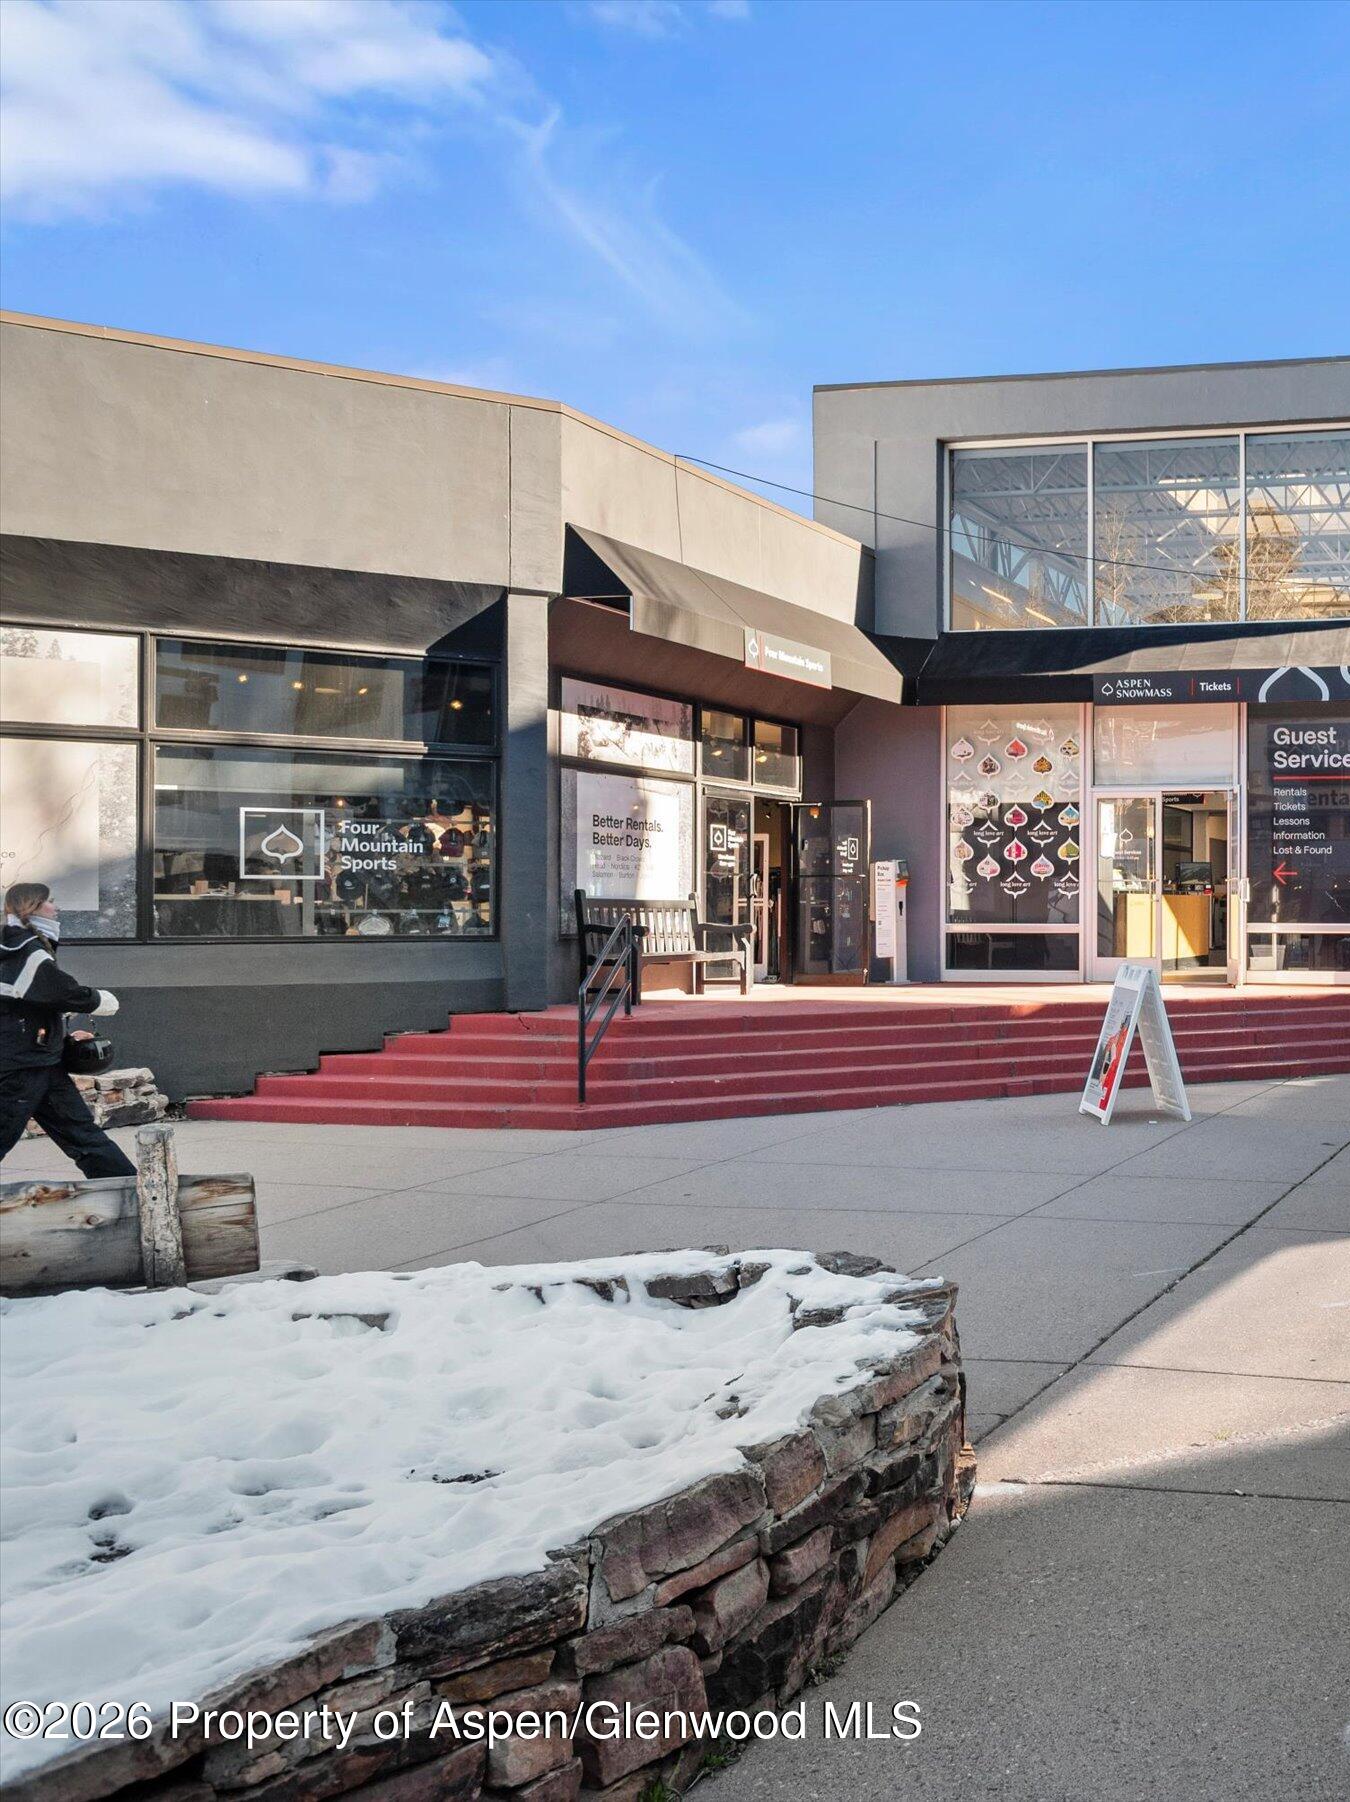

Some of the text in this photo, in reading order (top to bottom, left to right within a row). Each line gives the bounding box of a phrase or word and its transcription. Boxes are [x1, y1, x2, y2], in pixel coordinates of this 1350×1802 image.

[1116, 679, 1151, 688] ASPEN
[1200, 682, 1232, 691] Tickets
[1116, 688, 1172, 698] SNOWMASS
[1274, 727, 1336, 745] Guest
[1274, 788, 1307, 796] Rentals
[1274, 802, 1306, 810] Tickets
[592, 814, 664, 832] Better Rentals.
[1274, 817, 1310, 826] Lessons
[340, 820, 380, 834] Four
[1274, 831, 1325, 840] Information
[340, 838, 424, 853] Mountain
[592, 832, 652, 850] Better Days.
[1274, 846, 1332, 854] Lost & Found
[340, 856, 397, 872] Sports
